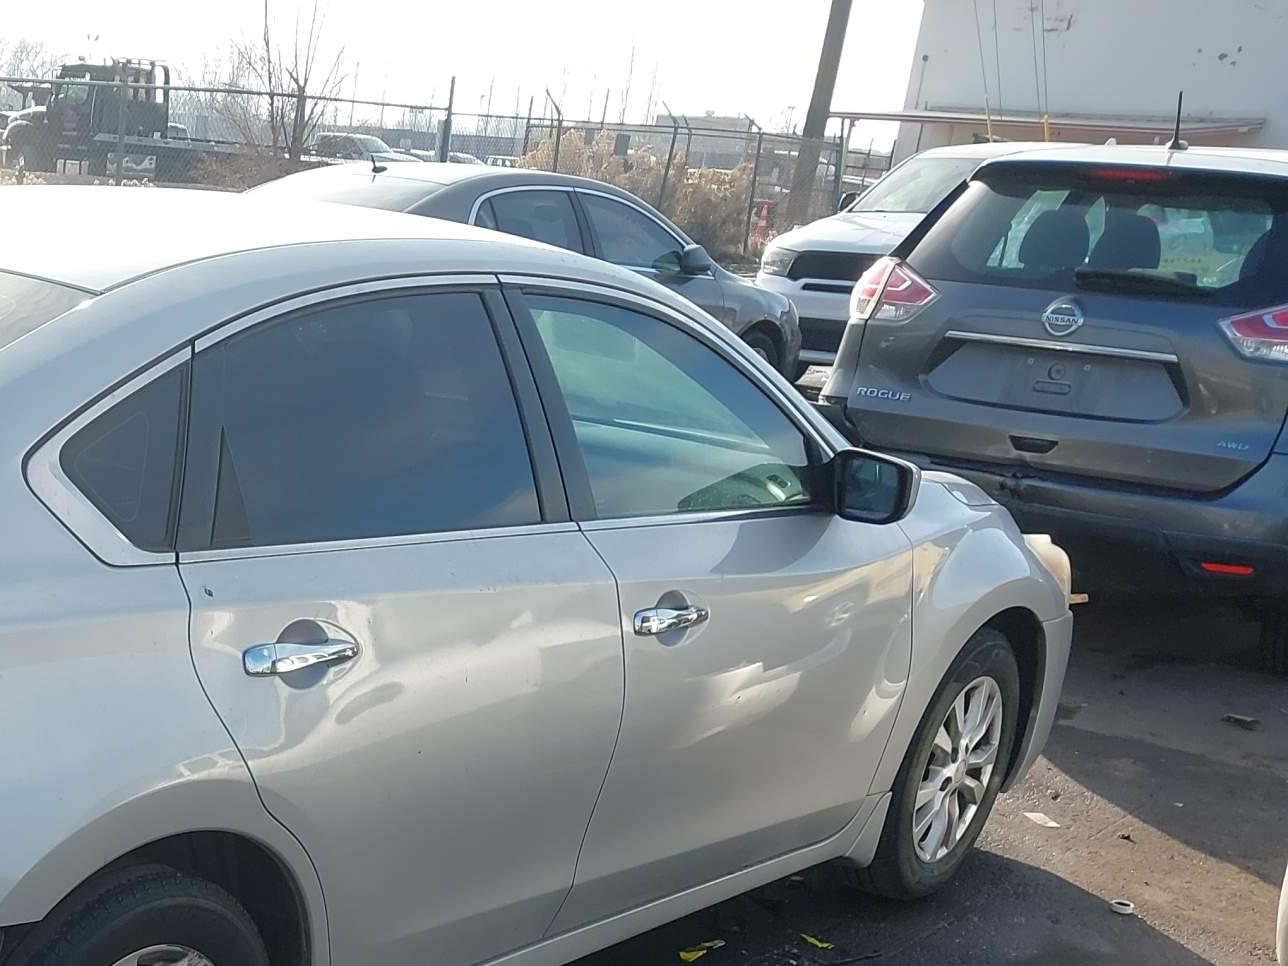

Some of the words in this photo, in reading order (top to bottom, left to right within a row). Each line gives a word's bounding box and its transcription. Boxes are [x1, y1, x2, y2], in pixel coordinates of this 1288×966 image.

[1045, 313, 1080, 326] NISSAN
[856, 387, 912, 401] ROGUE
[1215, 440, 1250, 450] AWD
